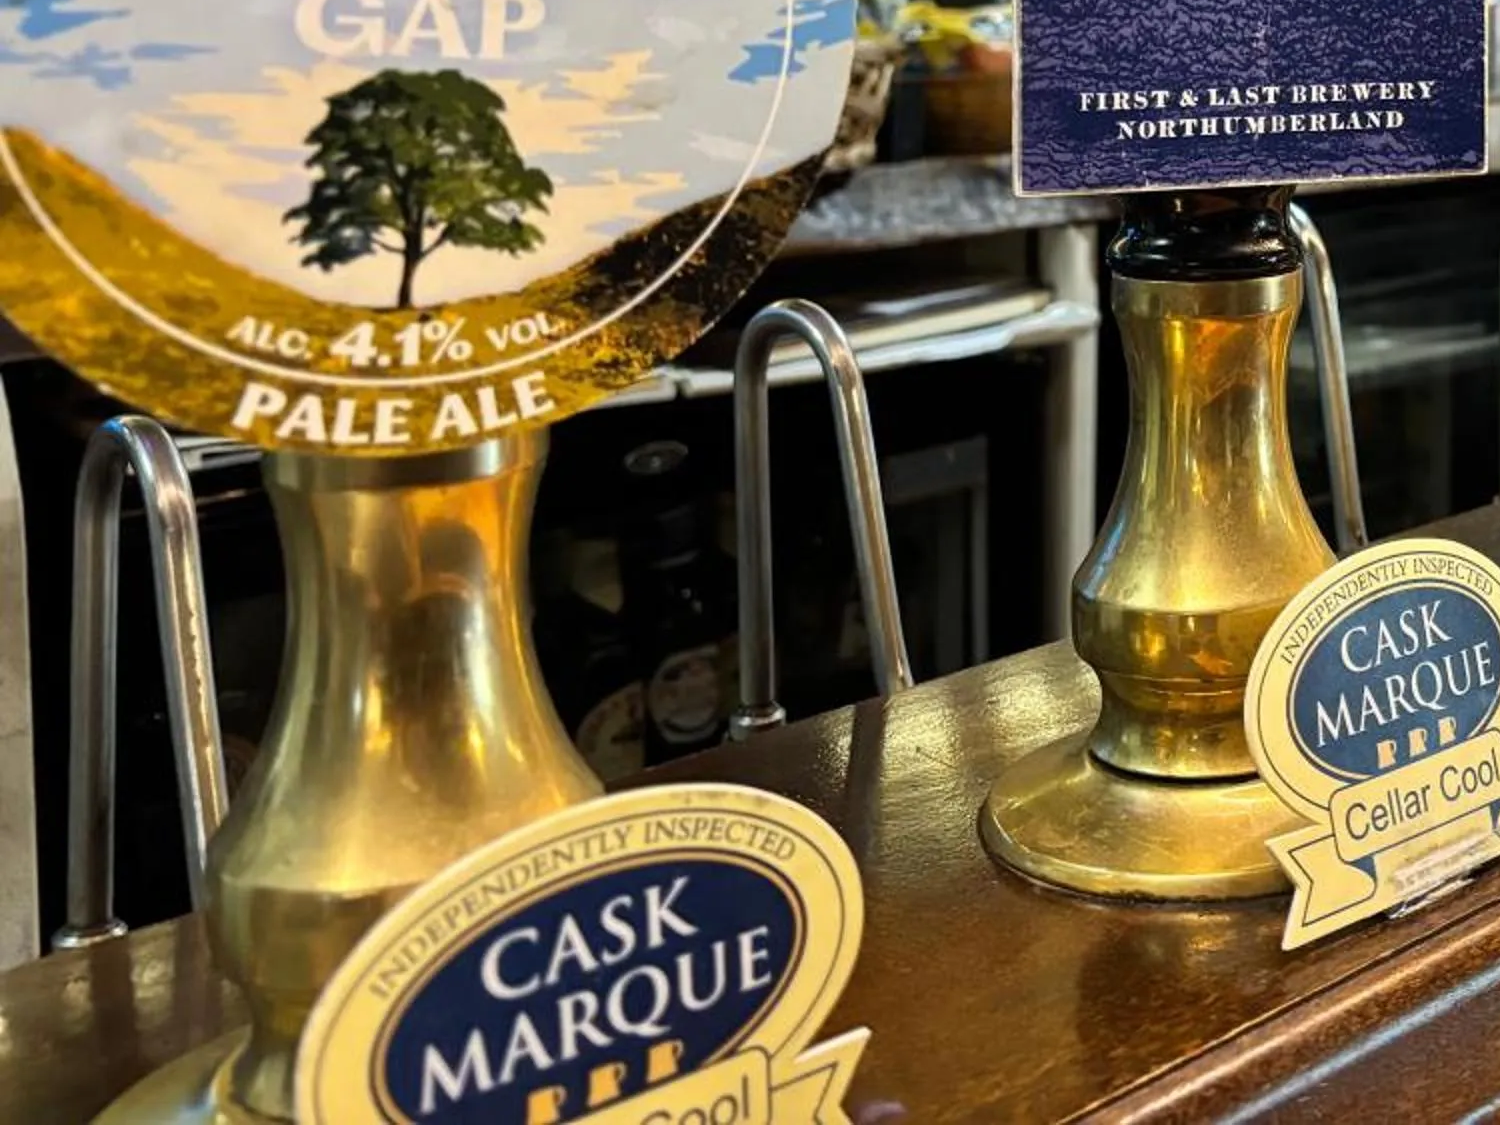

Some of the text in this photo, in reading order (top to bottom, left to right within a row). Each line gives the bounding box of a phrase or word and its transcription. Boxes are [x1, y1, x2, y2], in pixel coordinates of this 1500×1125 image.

[1080, 81, 1436, 112] FIRST & LAST BREWERY
[1117, 111, 1405, 140] NORTHUMBERLAND
[225, 315, 313, 360] ALC.
[329, 316, 474, 367] 4.1%
[231, 371, 557, 445] PALE ALE
[1280, 556, 1494, 665] INDEPENDENTLY INSPECTED
[1340, 600, 1453, 673] CASK
[1315, 642, 1495, 748] MARQUE
[1345, 748, 1500, 840] Cellar Cool
[369, 816, 797, 1001] INDEPENDENTLY INSPECTED
[481, 876, 698, 1000] CASK
[420, 926, 772, 1115] MARQUE
